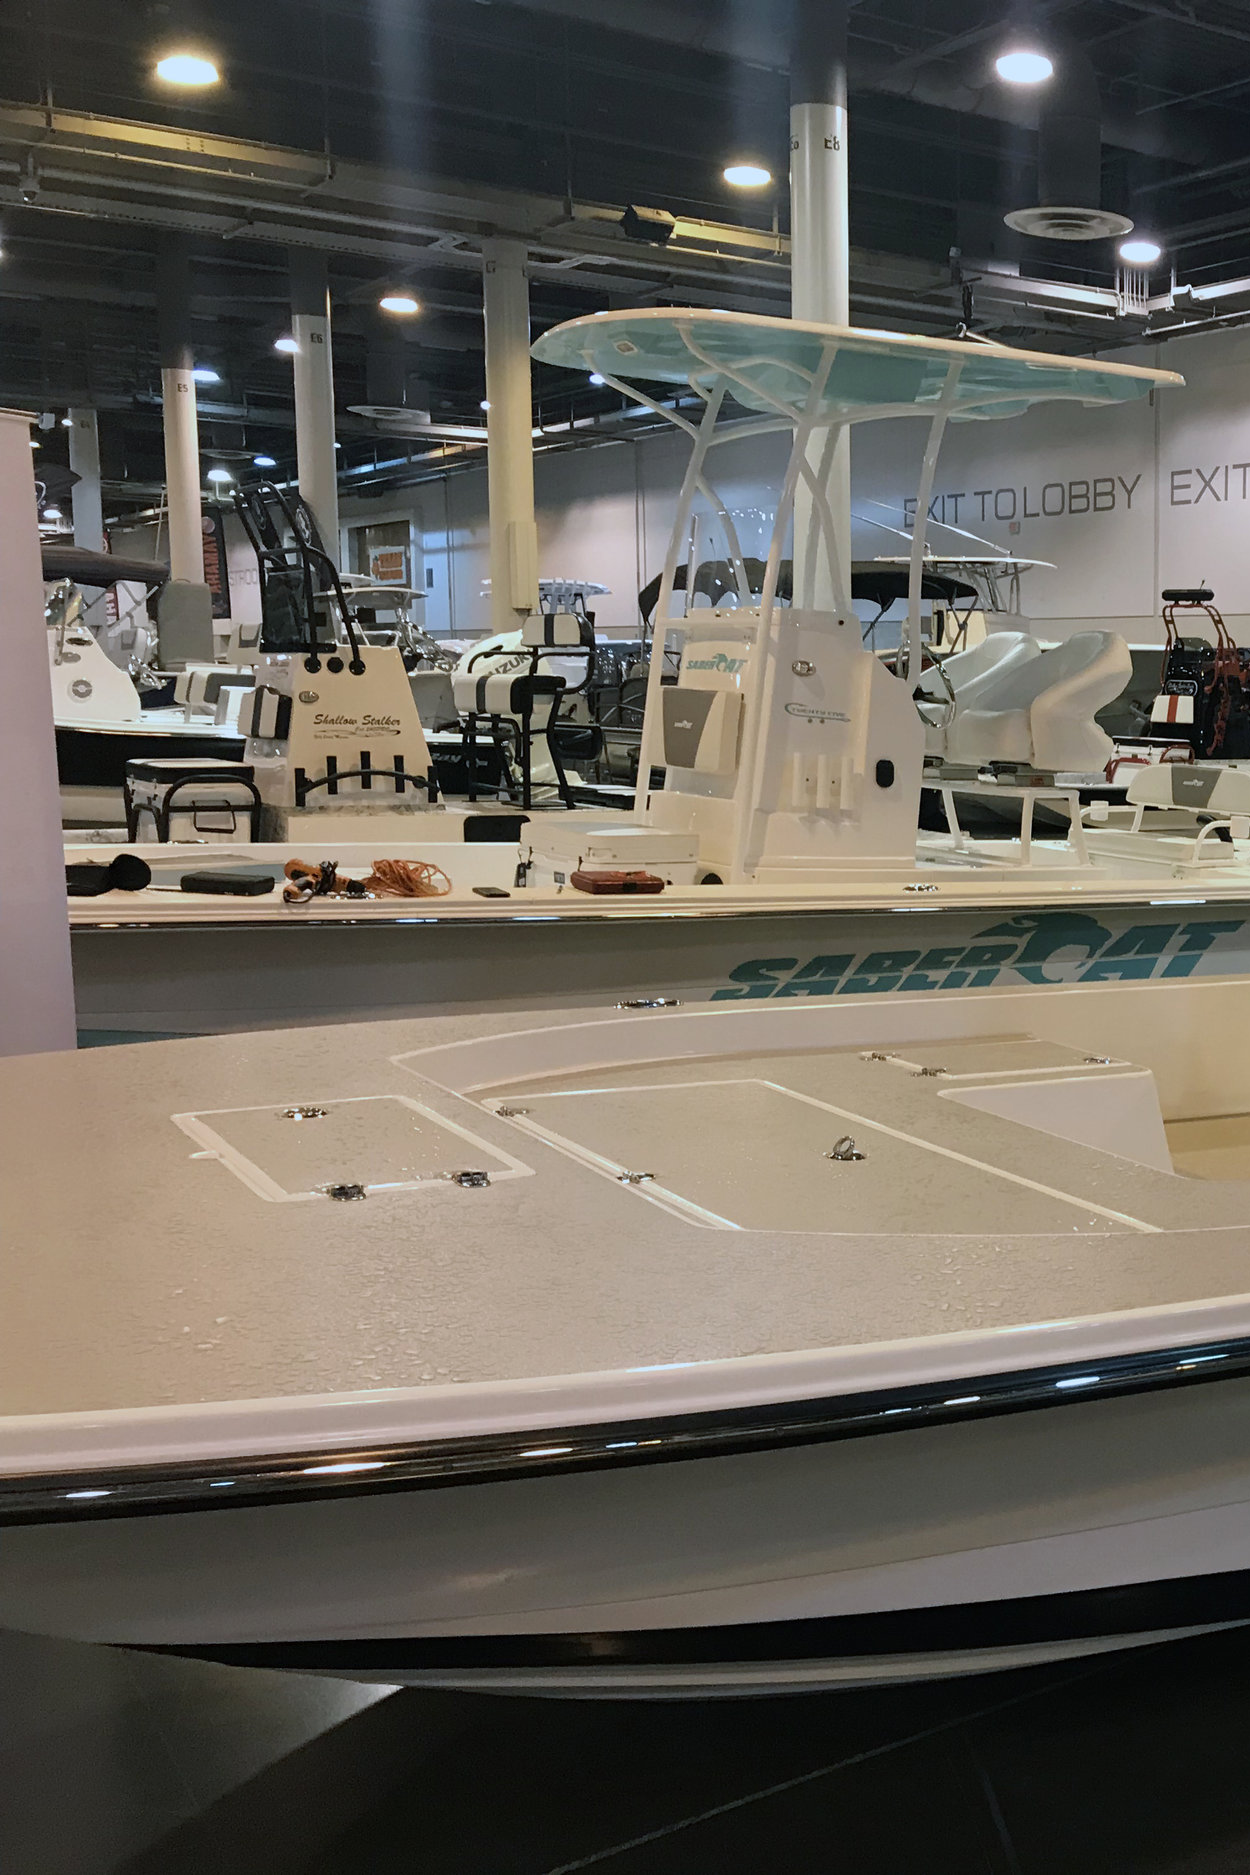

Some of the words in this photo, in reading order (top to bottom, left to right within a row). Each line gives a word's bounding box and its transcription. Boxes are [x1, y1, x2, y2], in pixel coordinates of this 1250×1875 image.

[824, 135, 840, 151] E8
[310, 332, 323, 344] E6
[177, 383, 189, 393] E5
[903, 493, 966, 528] EXIT
[973, 488, 1017, 521] TO
[1022, 474, 1142, 519] LOBBY
[313, 713, 358, 726] Shallow
[361, 714, 401, 727] Stalker
